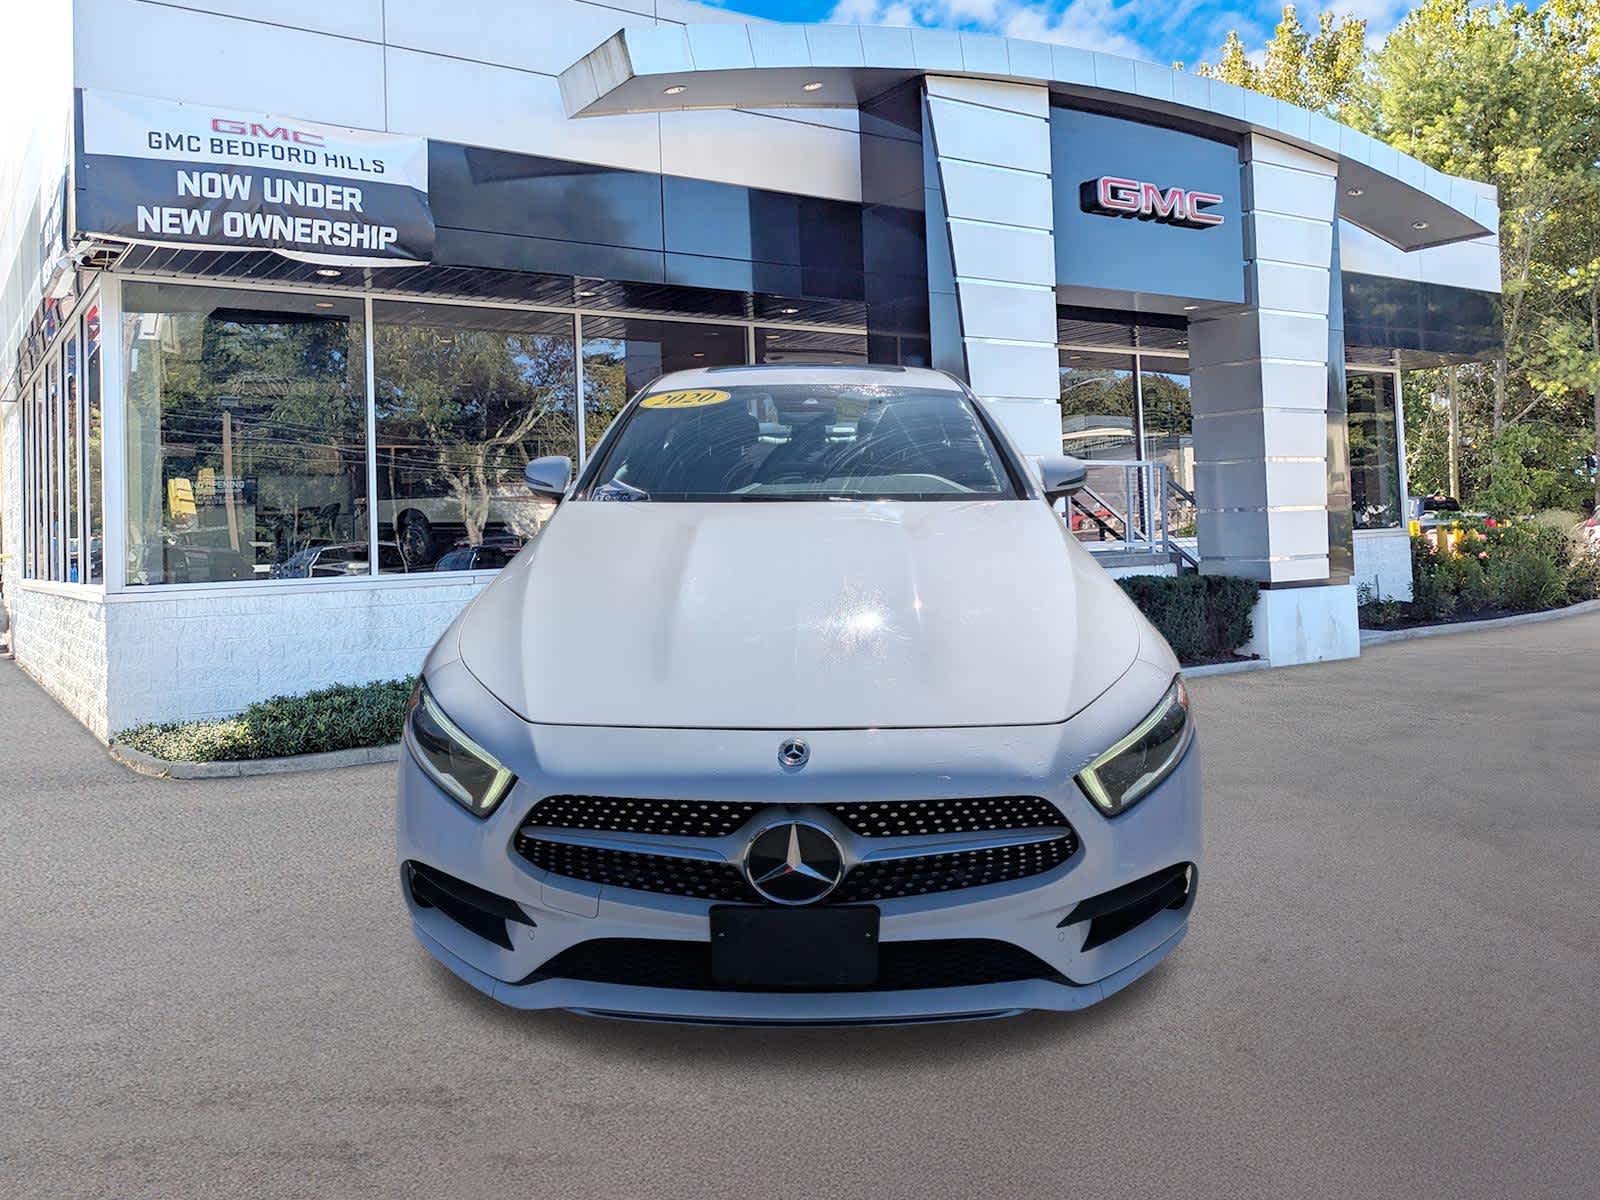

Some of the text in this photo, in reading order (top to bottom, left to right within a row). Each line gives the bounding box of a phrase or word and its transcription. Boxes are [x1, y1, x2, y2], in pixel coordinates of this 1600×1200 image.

[148, 131, 385, 174] GMC BEDFORD HILLS
[211, 118, 326, 147] GMC
[177, 170, 363, 212] NOW UNDER
[1098, 176, 1225, 225] GMC
[137, 206, 398, 250] NEW OWNERSHIP
[652, 392, 717, 406] 2020
